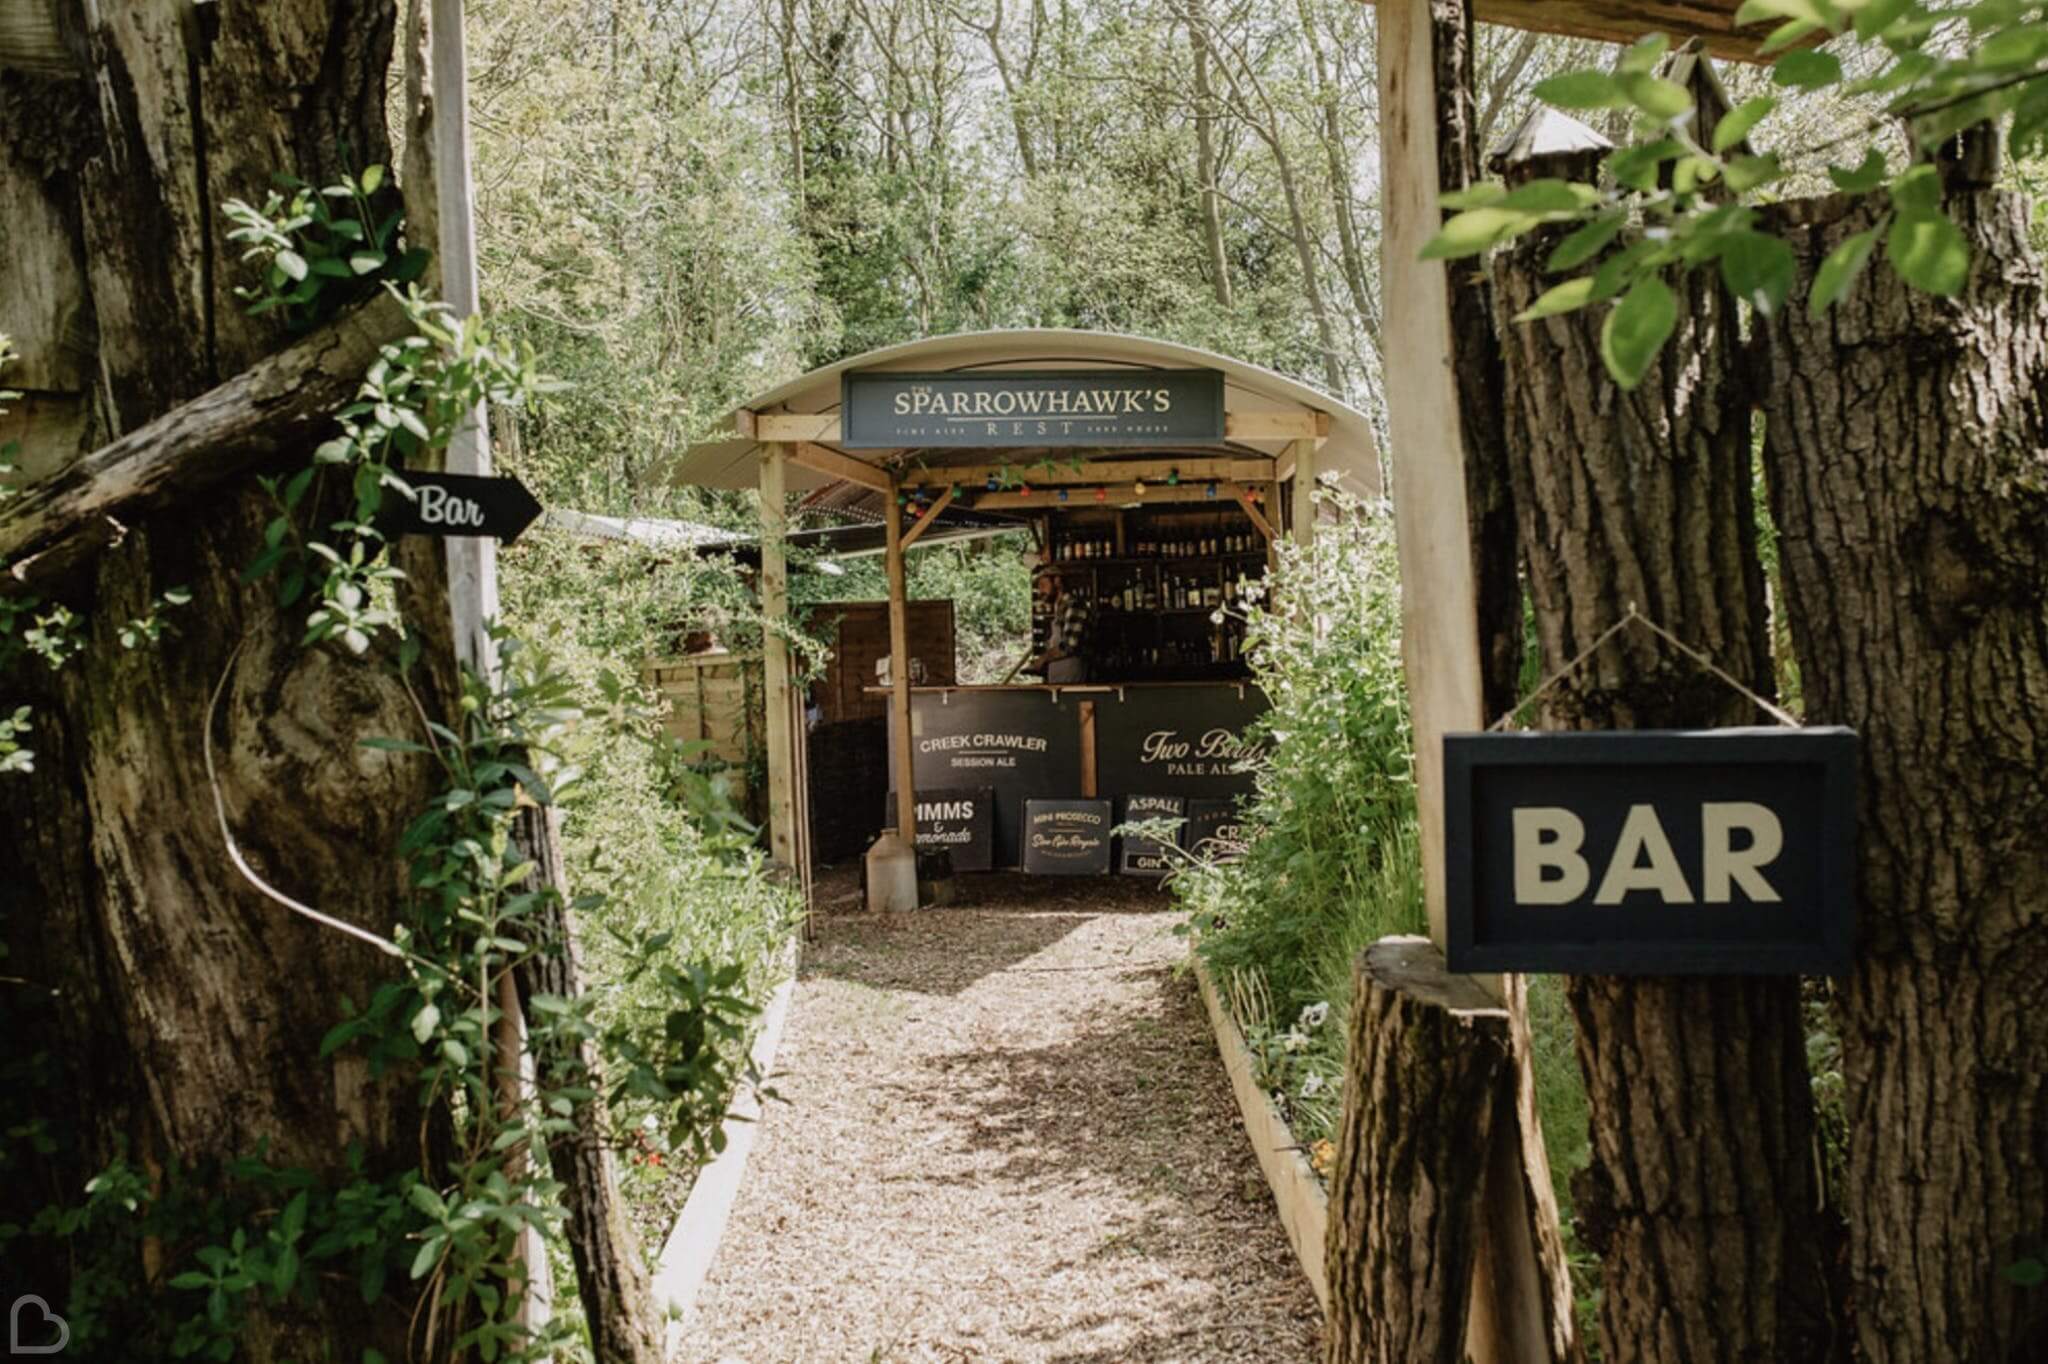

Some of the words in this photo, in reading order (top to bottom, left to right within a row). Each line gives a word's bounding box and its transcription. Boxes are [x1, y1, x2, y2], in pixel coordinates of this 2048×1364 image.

[894, 390, 1170, 415] SPARROWHAWK'S
[987, 421, 1073, 436] REST
[414, 485, 485, 526] Bar
[920, 735, 970, 752] CREEK
[972, 734, 1047, 752] CRAWLER
[1140, 731, 1190, 763] Two
[951, 758, 995, 767] SESSION
[996, 757, 1016, 767] ALE
[1167, 763, 1205, 775] PALE
[1209, 763, 1240, 775] AL
[914, 801, 974, 821] IMMS
[1128, 797, 1180, 813] ASPALL
[915, 826, 972, 843] monade
[1512, 802, 1784, 905] BAR
